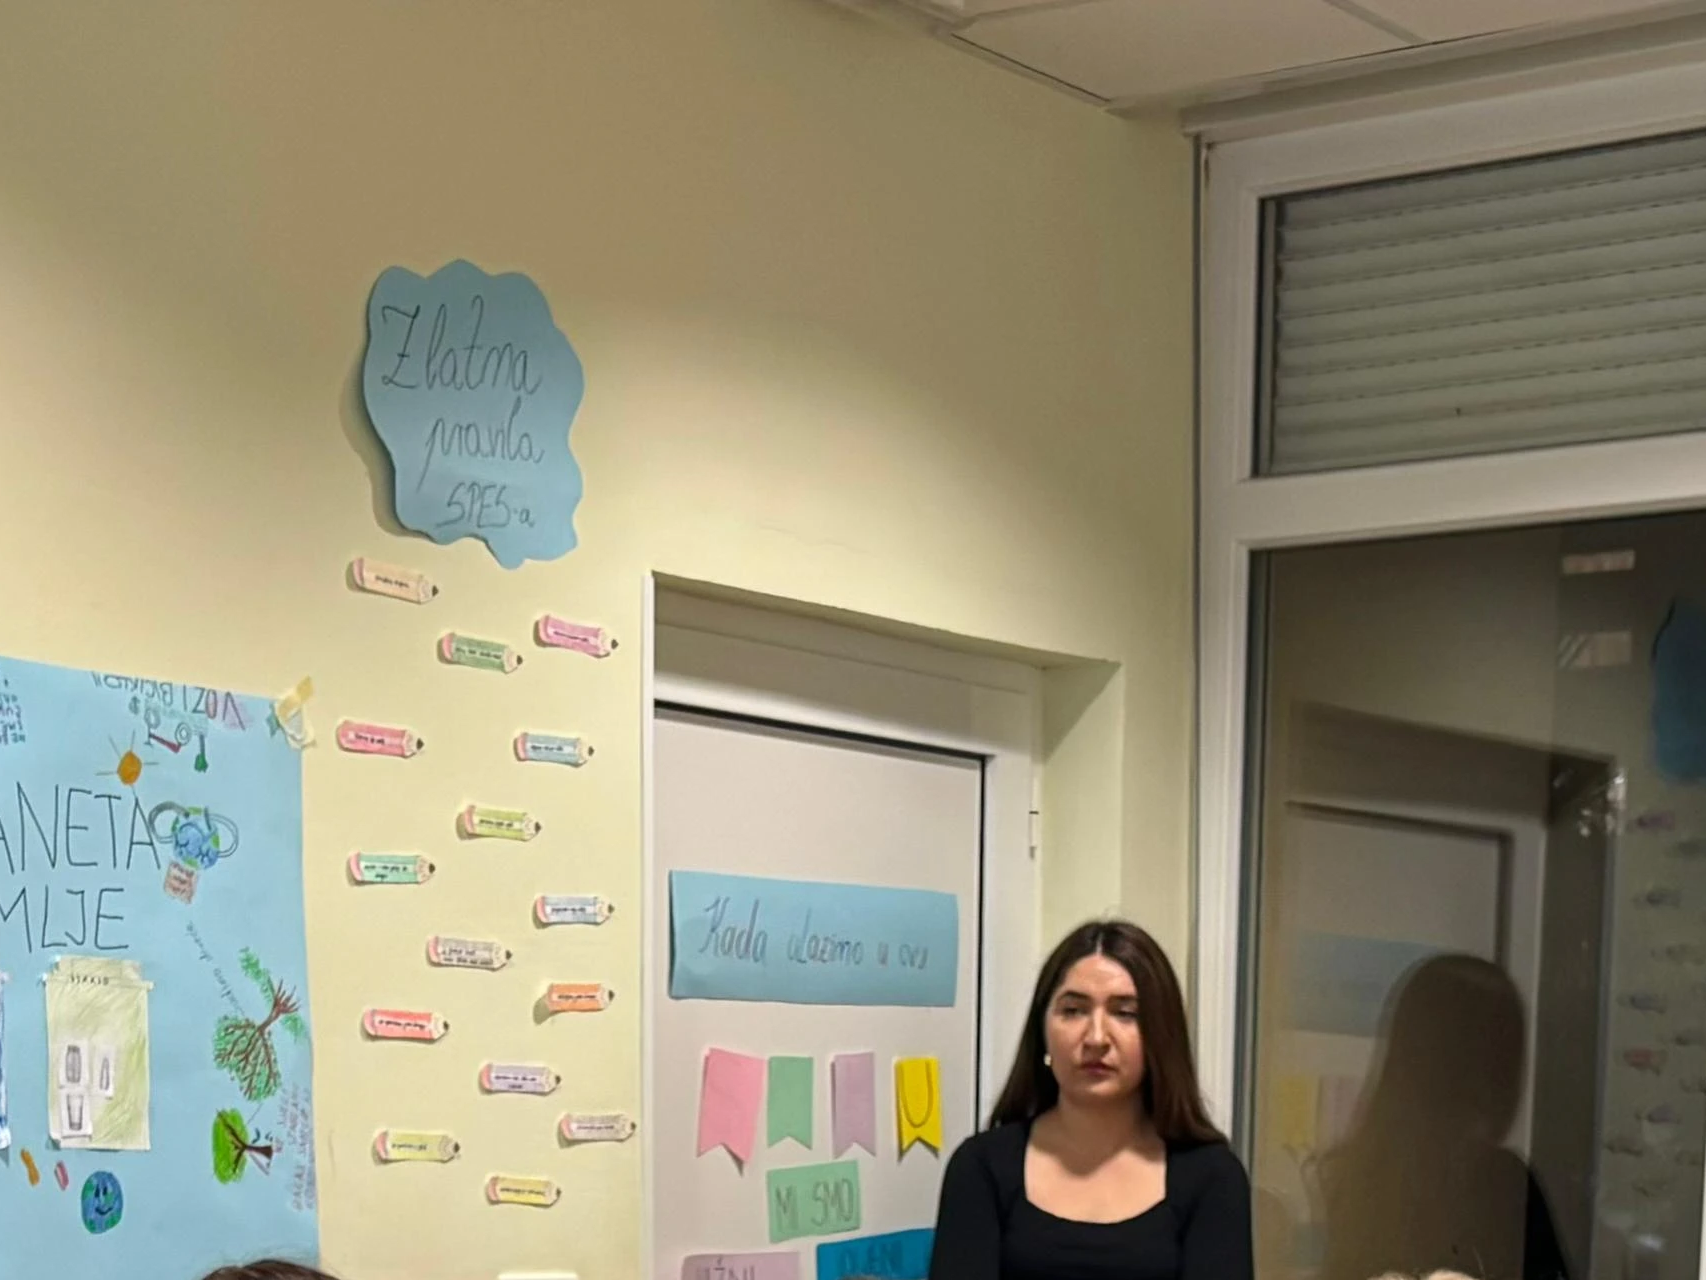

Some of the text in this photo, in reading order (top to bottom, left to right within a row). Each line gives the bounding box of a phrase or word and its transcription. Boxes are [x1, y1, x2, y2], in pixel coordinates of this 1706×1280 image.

[381, 294, 543, 396] Zlatna
[415, 395, 545, 494] pravila
[182, 684, 246, 731] VOZI
[698, 896, 769, 965] Kada
[810, 1178, 855, 1228] SMO
